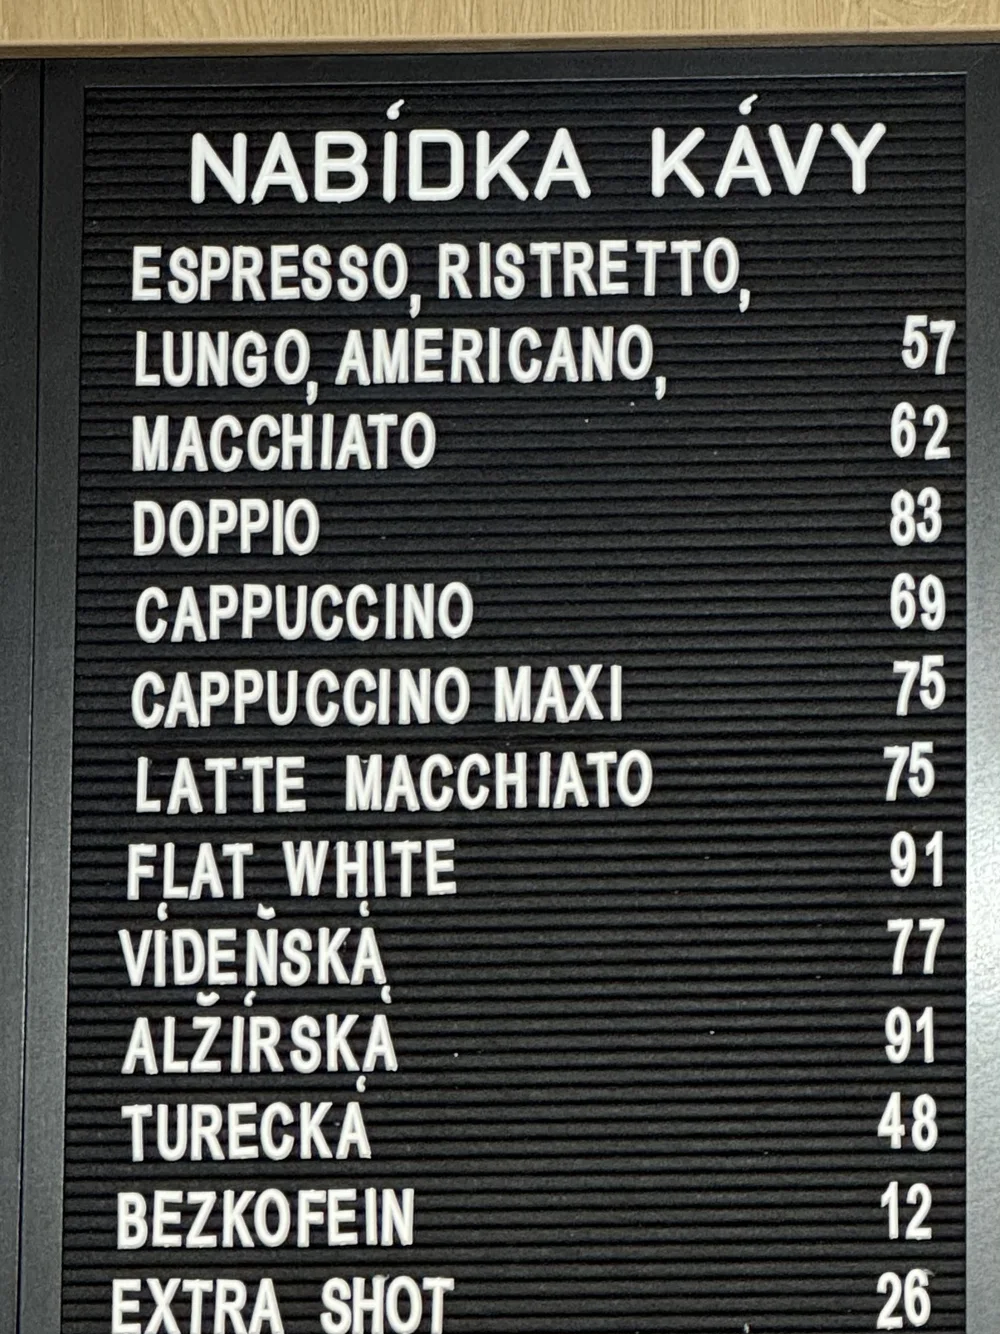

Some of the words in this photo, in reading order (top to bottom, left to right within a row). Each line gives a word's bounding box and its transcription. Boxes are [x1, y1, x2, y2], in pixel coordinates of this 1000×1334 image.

[190, 98, 592, 205] NABÍDKA
[651, 93, 887, 198] KÁVY
[131, 242, 422, 319] ESPRESSO,
[438, 236, 751, 313] RISTRETTO,
[135, 328, 319, 406] LUNGO,
[334, 323, 667, 401] AMERICANO,
[901, 314, 956, 375] 57
[132, 411, 436, 473] MACCHIATO
[890, 401, 951, 461] 62
[133, 498, 320, 557] DOPPIO
[889, 486, 943, 547] 83
[135, 581, 474, 644] CAPPUCCINO
[890, 572, 946, 631] 69
[131, 666, 471, 730] CAPPUCCINO
[494, 663, 623, 724] MAXI
[892, 654, 946, 716] 75
[136, 755, 307, 815] LATTE
[345, 748, 653, 812] MACCHIATO
[883, 741, 935, 801] 75
[127, 841, 254, 901] FLAT
[282, 838, 457, 899] WHITE
[890, 830, 943, 887] 91
[117, 900, 387, 987] VÍDEŇSKÁ
[887, 917, 945, 975] 77
[121, 985, 399, 1075] ALŽÍRSKÁ
[884, 1005, 935, 1064] 91
[121, 1075, 372, 1162] TURECKÁ
[877, 1091, 938, 1152] 48
[117, 1187, 415, 1250] BEZKOFEIN
[880, 1180, 933, 1241] 12
[876, 1267, 932, 1331] 26
